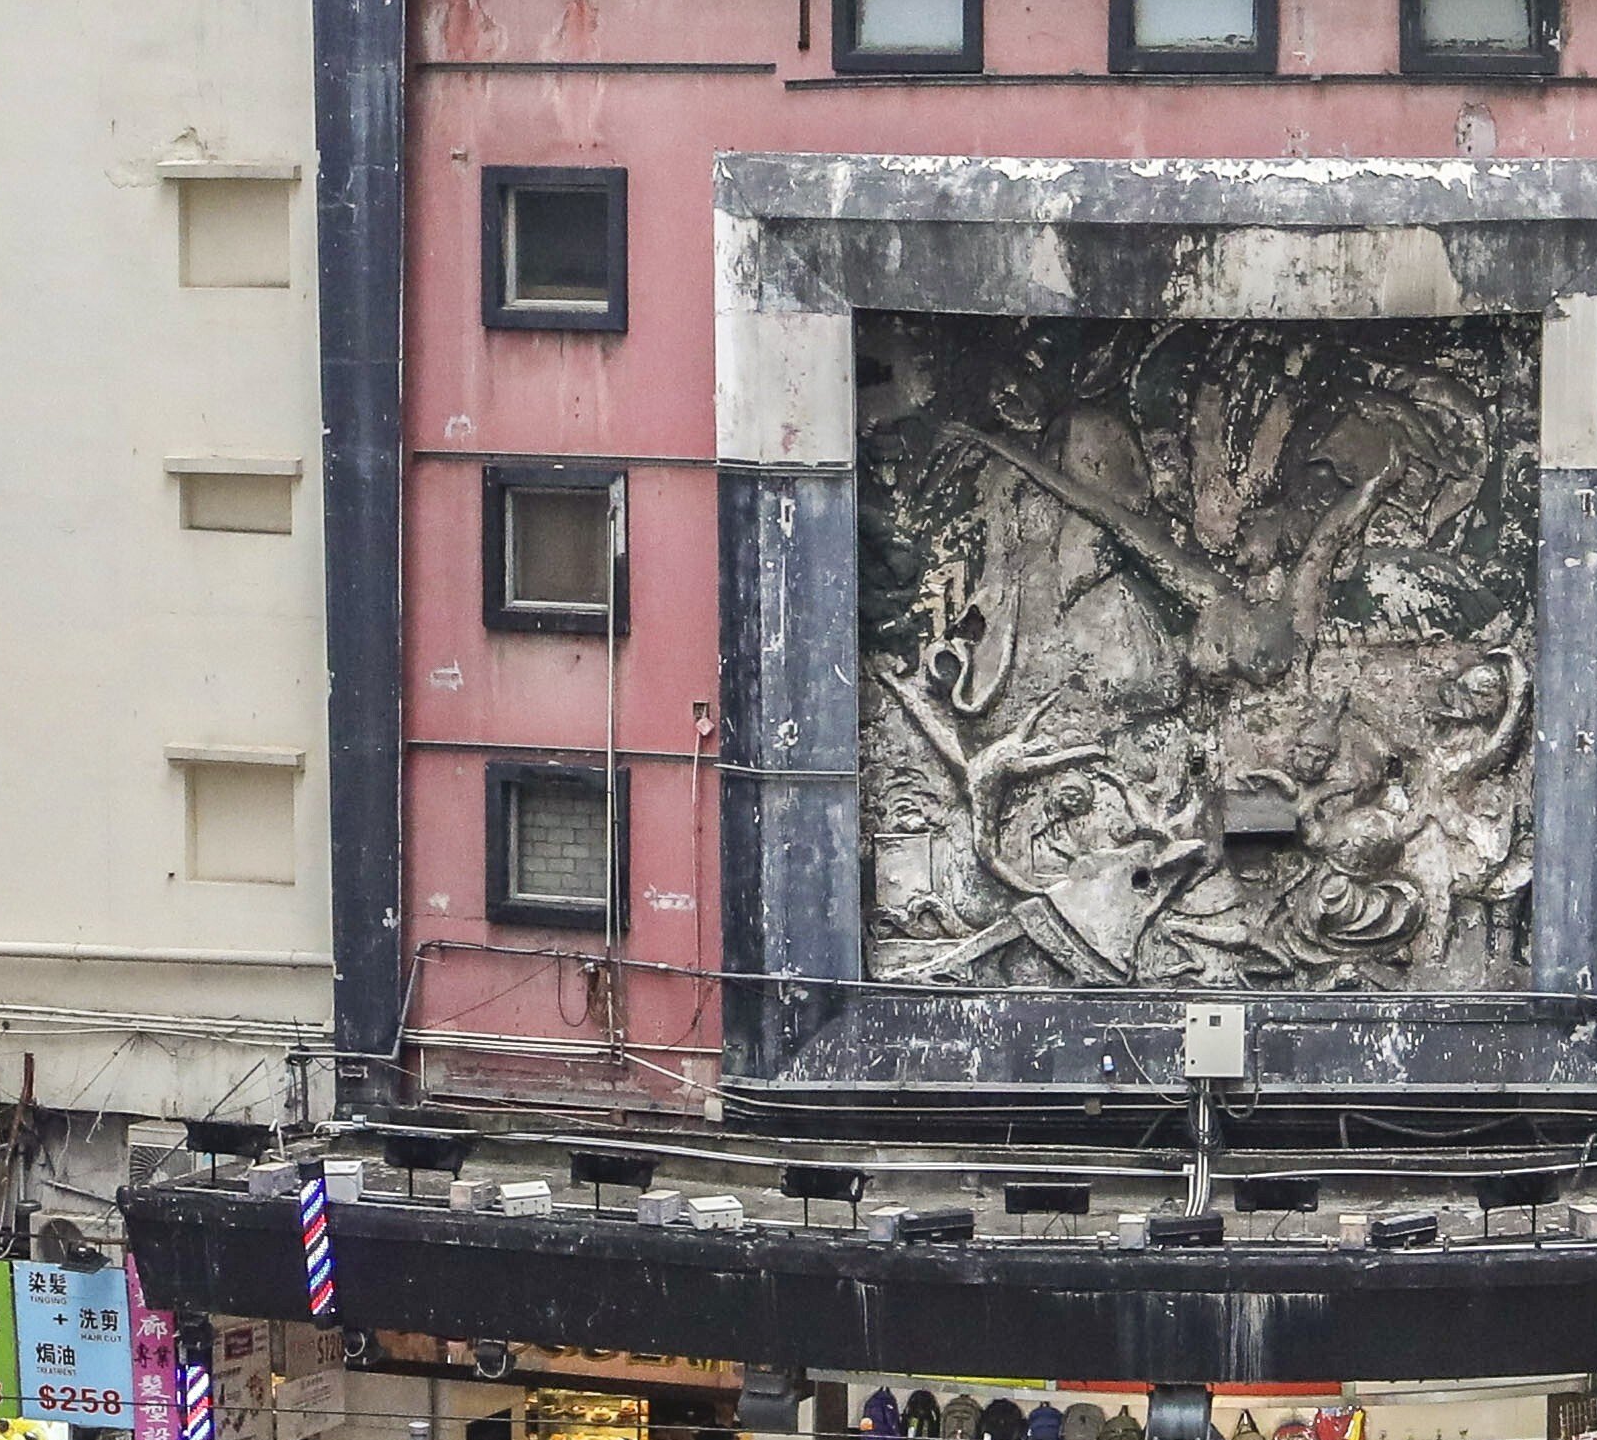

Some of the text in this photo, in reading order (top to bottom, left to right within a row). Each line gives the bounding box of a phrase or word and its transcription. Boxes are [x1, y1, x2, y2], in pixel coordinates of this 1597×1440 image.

[28, 1271, 67, 1296] 染髮
[79, 1309, 119, 1332] 洗剪
[81, 1332, 122, 1343] HAIR CUT
[36, 1343, 76, 1366] 焗油
[38, 1384, 122, 1415] $258
